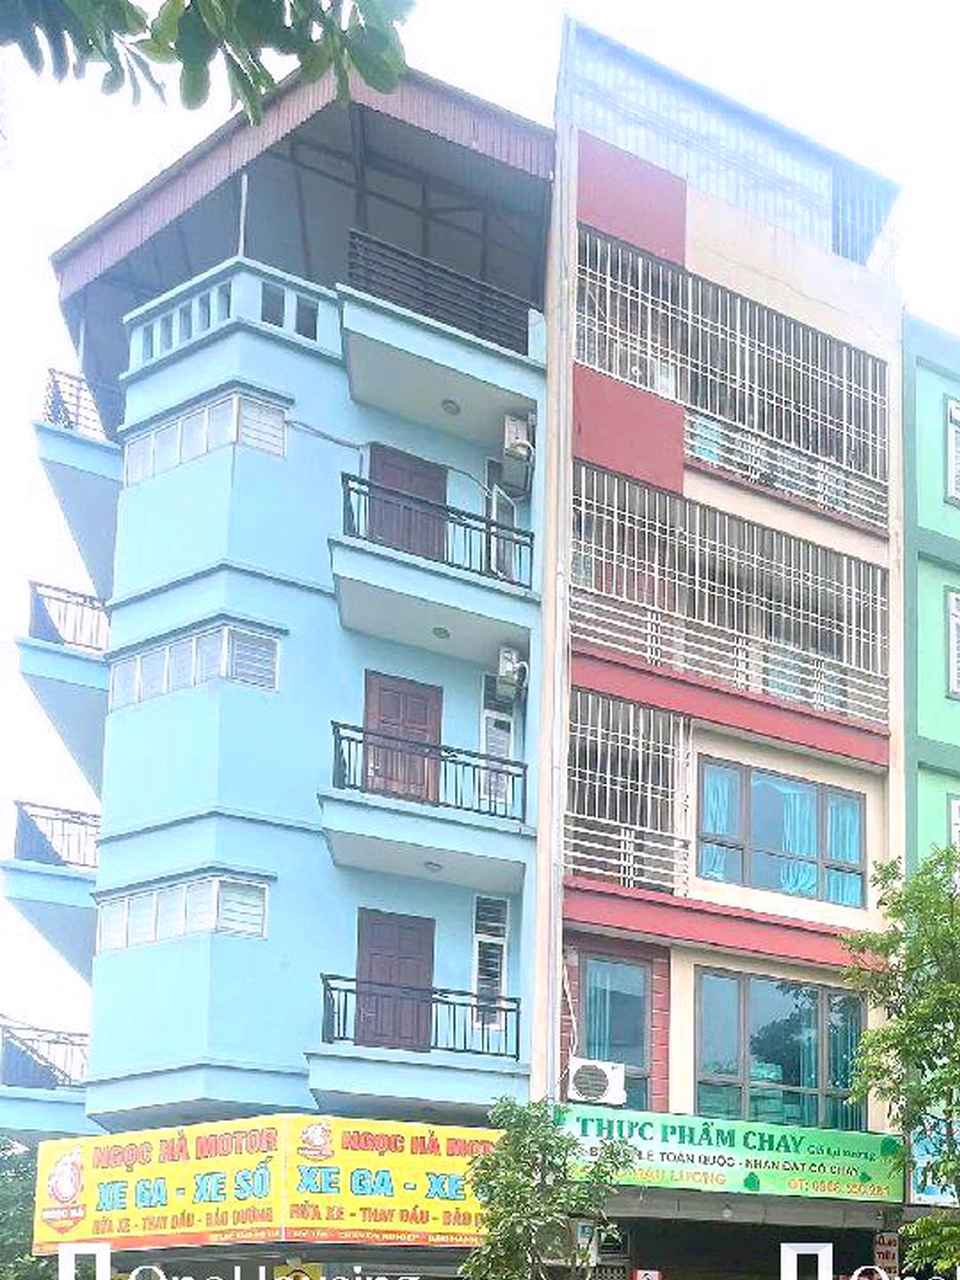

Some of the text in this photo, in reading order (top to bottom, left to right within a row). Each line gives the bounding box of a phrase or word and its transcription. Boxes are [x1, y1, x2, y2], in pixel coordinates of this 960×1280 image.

[93, 1127, 278, 1172] NGỌC HÀ MOTOR
[341, 1131, 405, 1156] NGỌC
[410, 1129, 441, 1156] HÀ
[661, 1122, 736, 1148] PHẨM
[743, 1131, 806, 1154] CHAY
[96, 1180, 128, 1211] XE
[135, 1176, 168, 1209] GA
[193, 1171, 227, 1205] XE
[234, 1156, 273, 1201] SỐ
[297, 1165, 340, 1194] XE
[350, 1168, 394, 1197] GA
[425, 1171, 466, 1201] XE
[326, 1206, 344, 1221] XE
